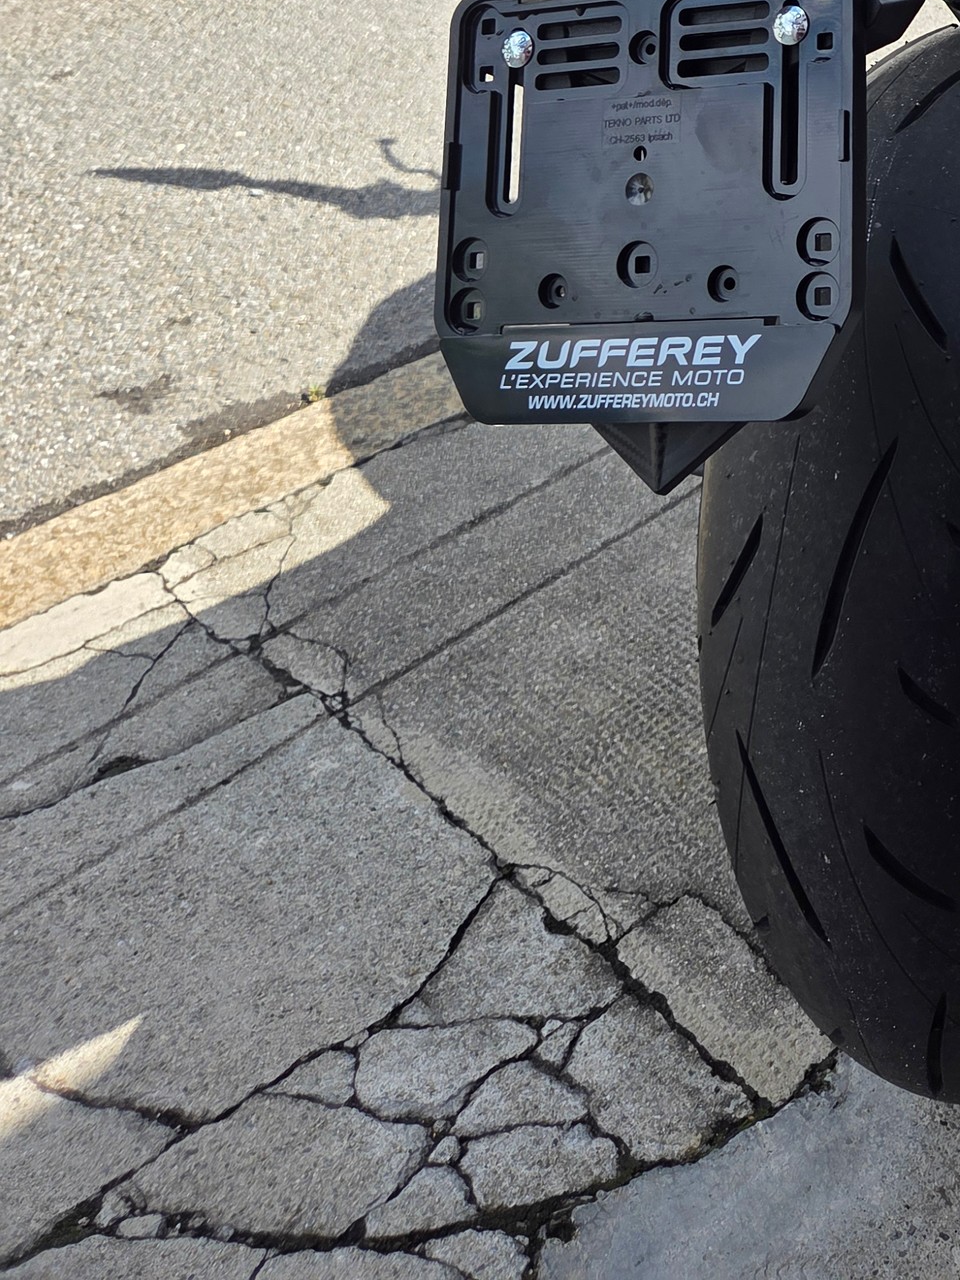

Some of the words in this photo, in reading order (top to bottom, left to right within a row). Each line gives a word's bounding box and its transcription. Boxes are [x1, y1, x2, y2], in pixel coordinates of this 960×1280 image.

[604, 118, 632, 129] TEKNO
[634, 115, 663, 126] PARTS
[665, 113, 681, 124] LTD
[504, 334, 762, 370] ZUFFEREY
[500, 371, 663, 390] L'EXPERIENCE
[671, 369, 745, 387] MOTO
[528, 392, 720, 410] WWW.ZUFFEREYMOTO.CH
